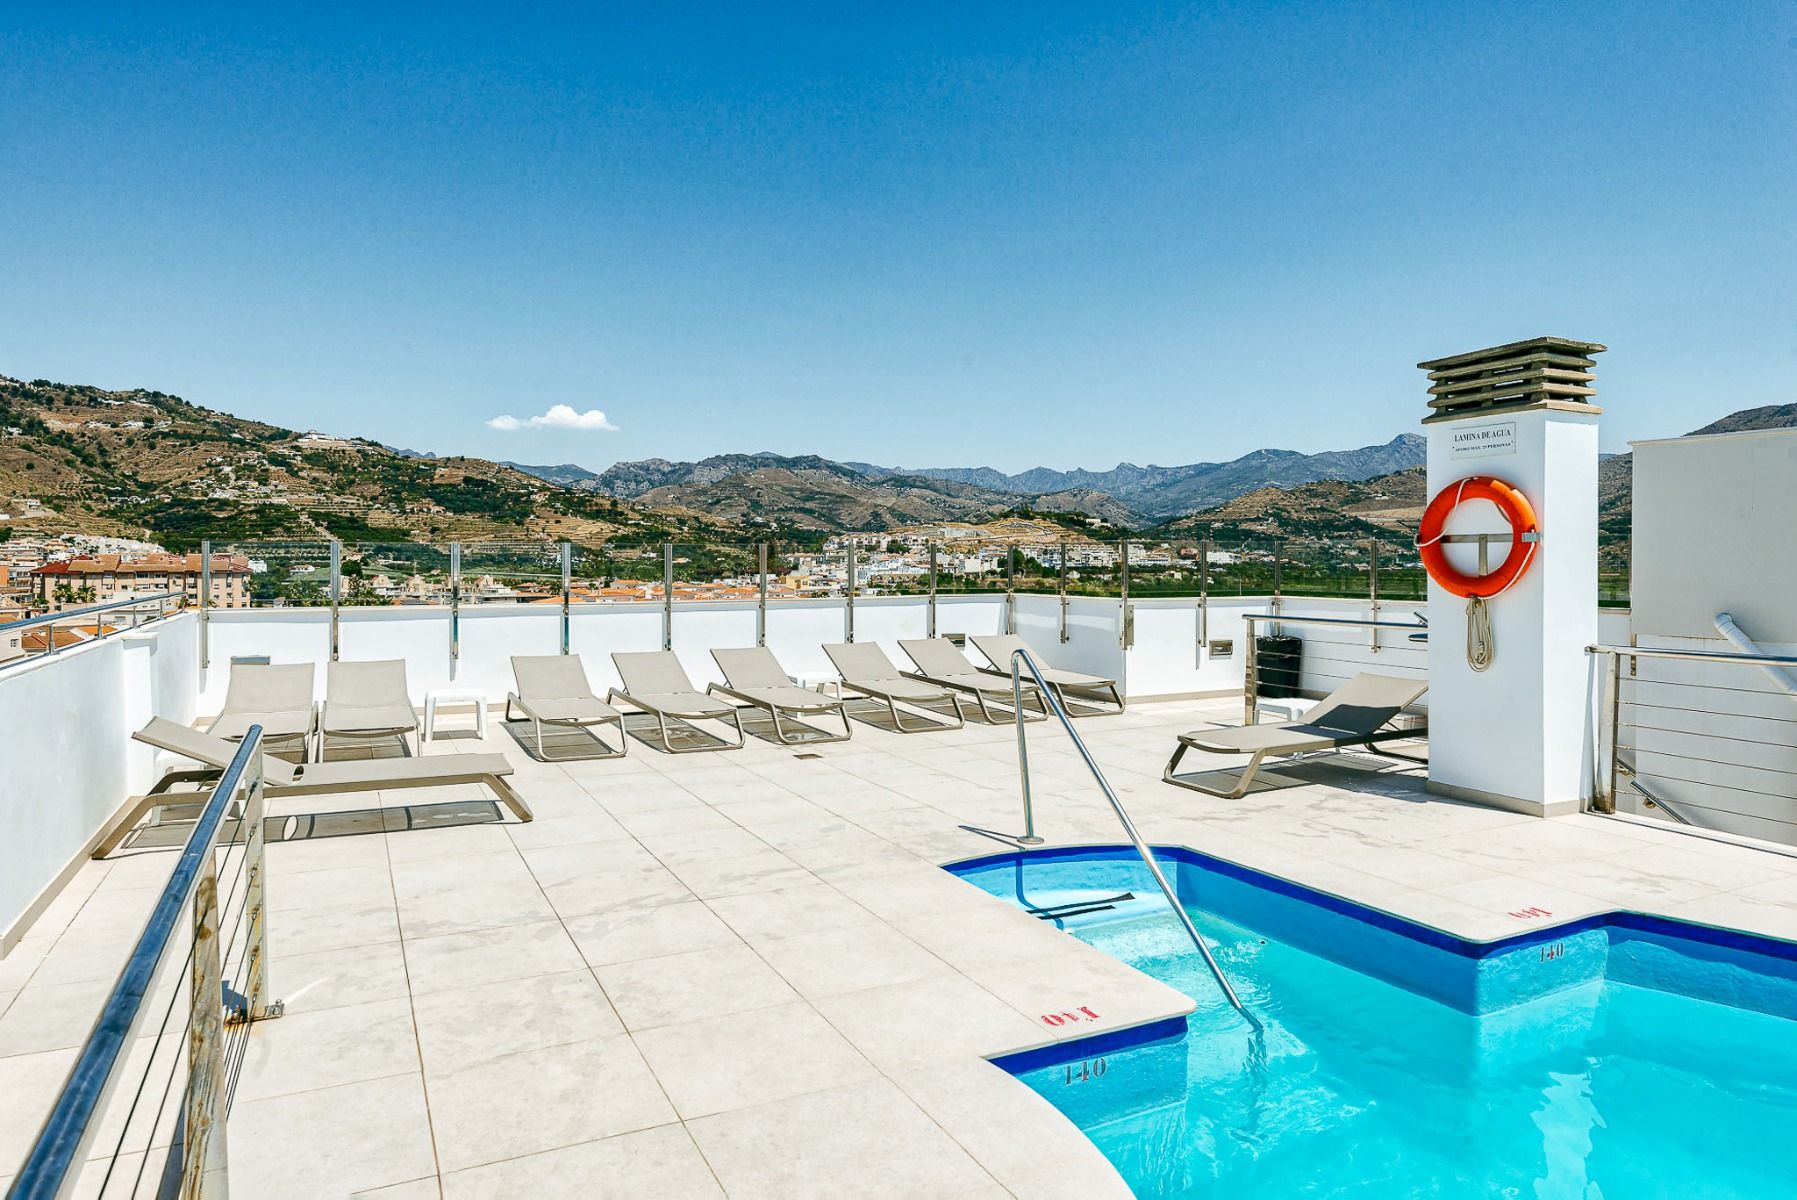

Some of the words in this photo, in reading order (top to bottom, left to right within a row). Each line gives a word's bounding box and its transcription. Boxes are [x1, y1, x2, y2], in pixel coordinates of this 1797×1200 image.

[1454, 432, 1480, 442] LAMINA
[1481, 431, 1490, 439] DE
[1492, 429, 1511, 438] AGUA
[1540, 943, 1564, 962] 140
[1064, 1057, 1107, 1085] 140
